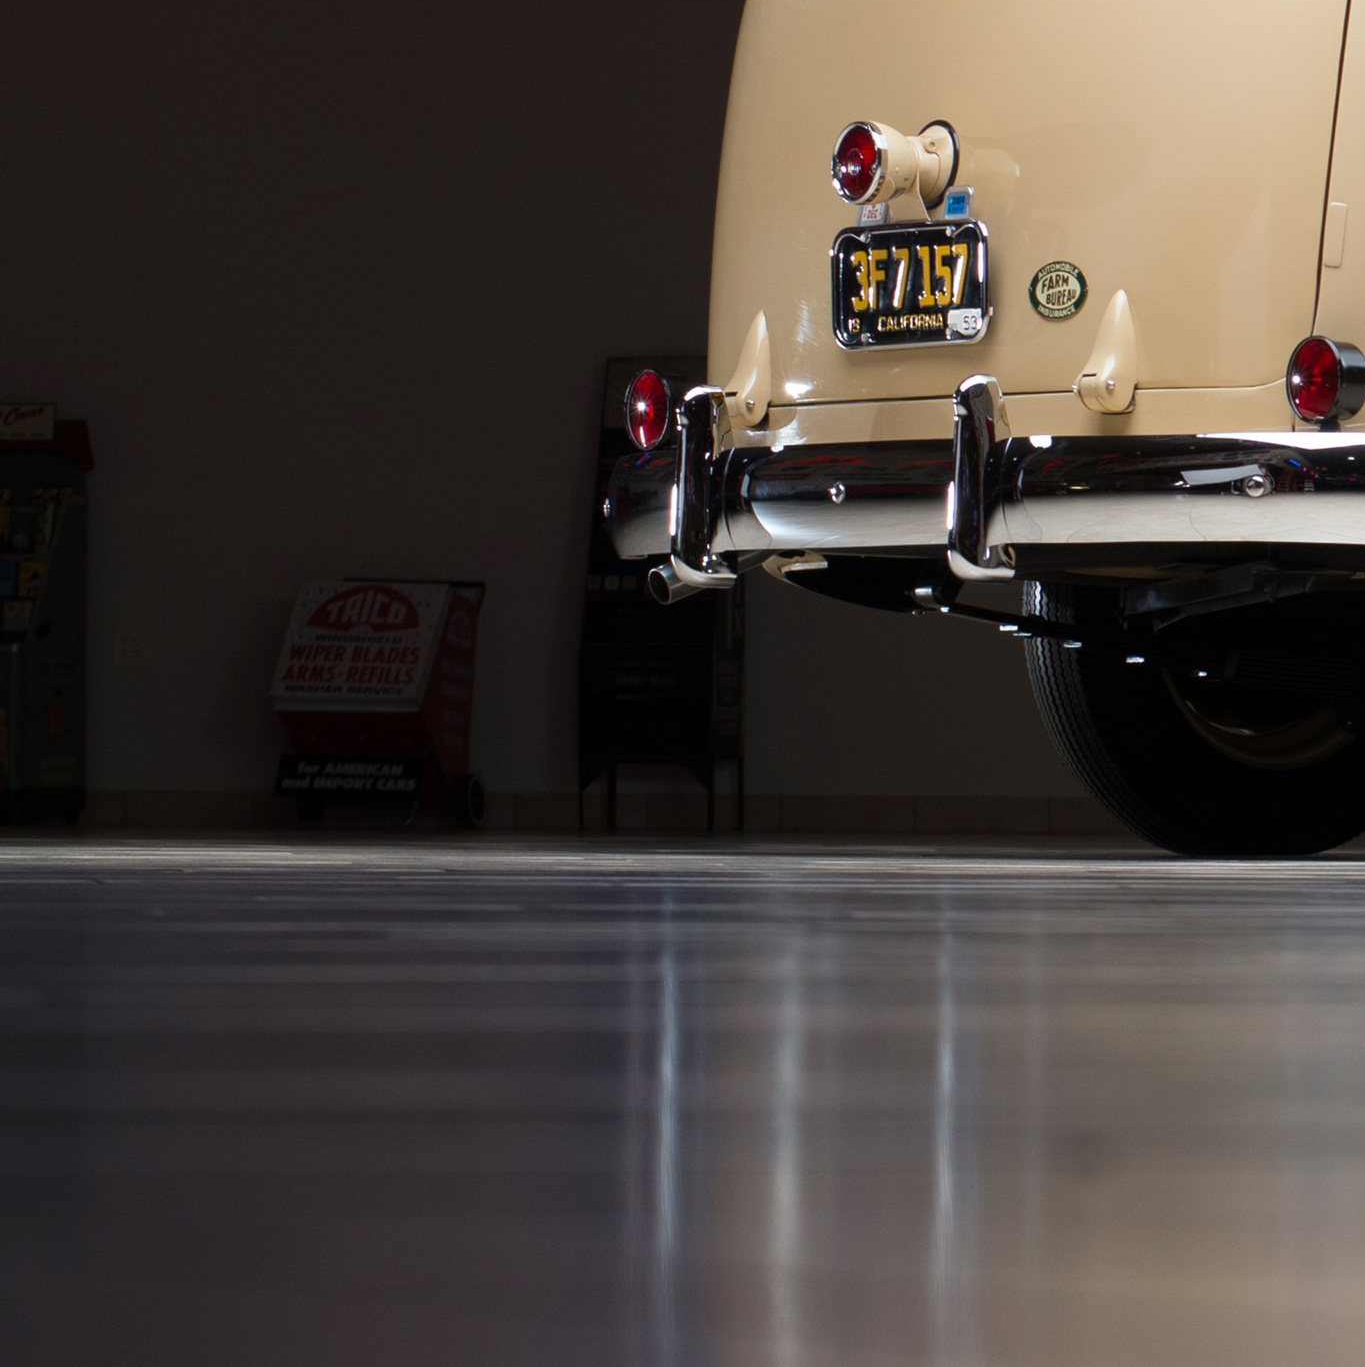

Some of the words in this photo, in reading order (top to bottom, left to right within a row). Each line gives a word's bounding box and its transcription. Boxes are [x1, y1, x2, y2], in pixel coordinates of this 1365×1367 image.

[1038, 263, 1080, 279] AUTOMOBILE
[1041, 274, 1070, 295] FARM
[1045, 289, 1077, 306] BUREAU
[877, 313, 944, 332] CALIFORNIA
[963, 315, 978, 330] 53
[325, 587, 410, 624] TRICO
[314, 634, 402, 645] WINDSHIELD
[290, 644, 347, 663] WIPER
[351, 645, 421, 664] BLADES
[284, 684, 343, 694] WASHER
[347, 685, 404, 695] SERVICE
[323, 761, 404, 777] AMERICAN
[280, 775, 312, 790] and
[313, 777, 373, 791] IMPORT
[374, 777, 418, 792] CARS
